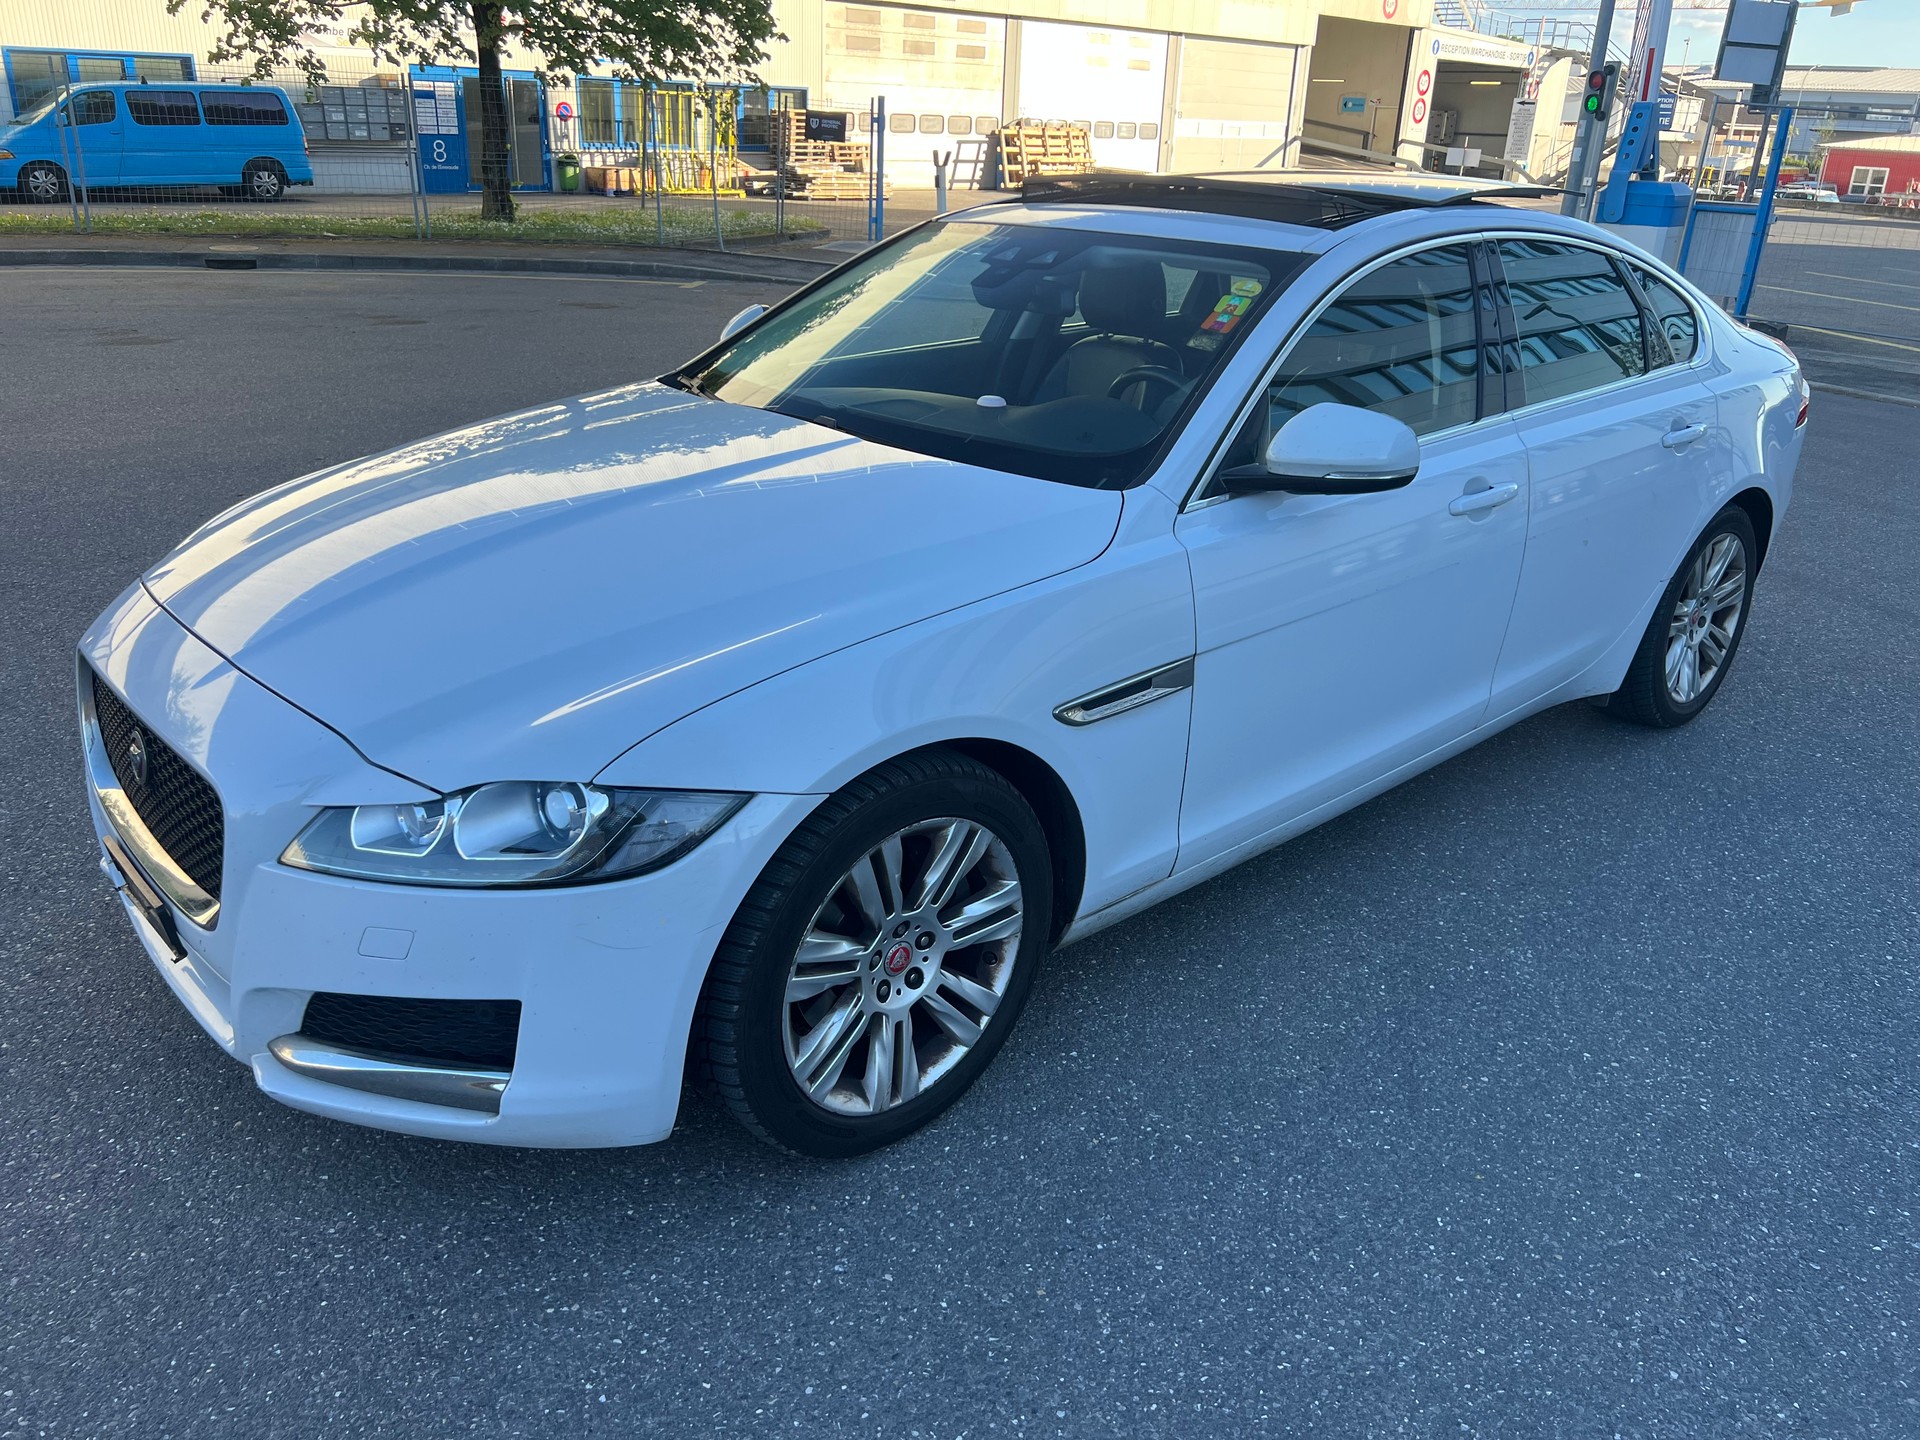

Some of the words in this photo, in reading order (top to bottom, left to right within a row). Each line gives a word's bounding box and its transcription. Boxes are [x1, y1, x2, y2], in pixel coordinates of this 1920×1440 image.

[1441, 43, 1470, 55] RECEPTION
[1470, 47, 1506, 59] MARCHANDISE
[433, 140, 447, 162] 8
